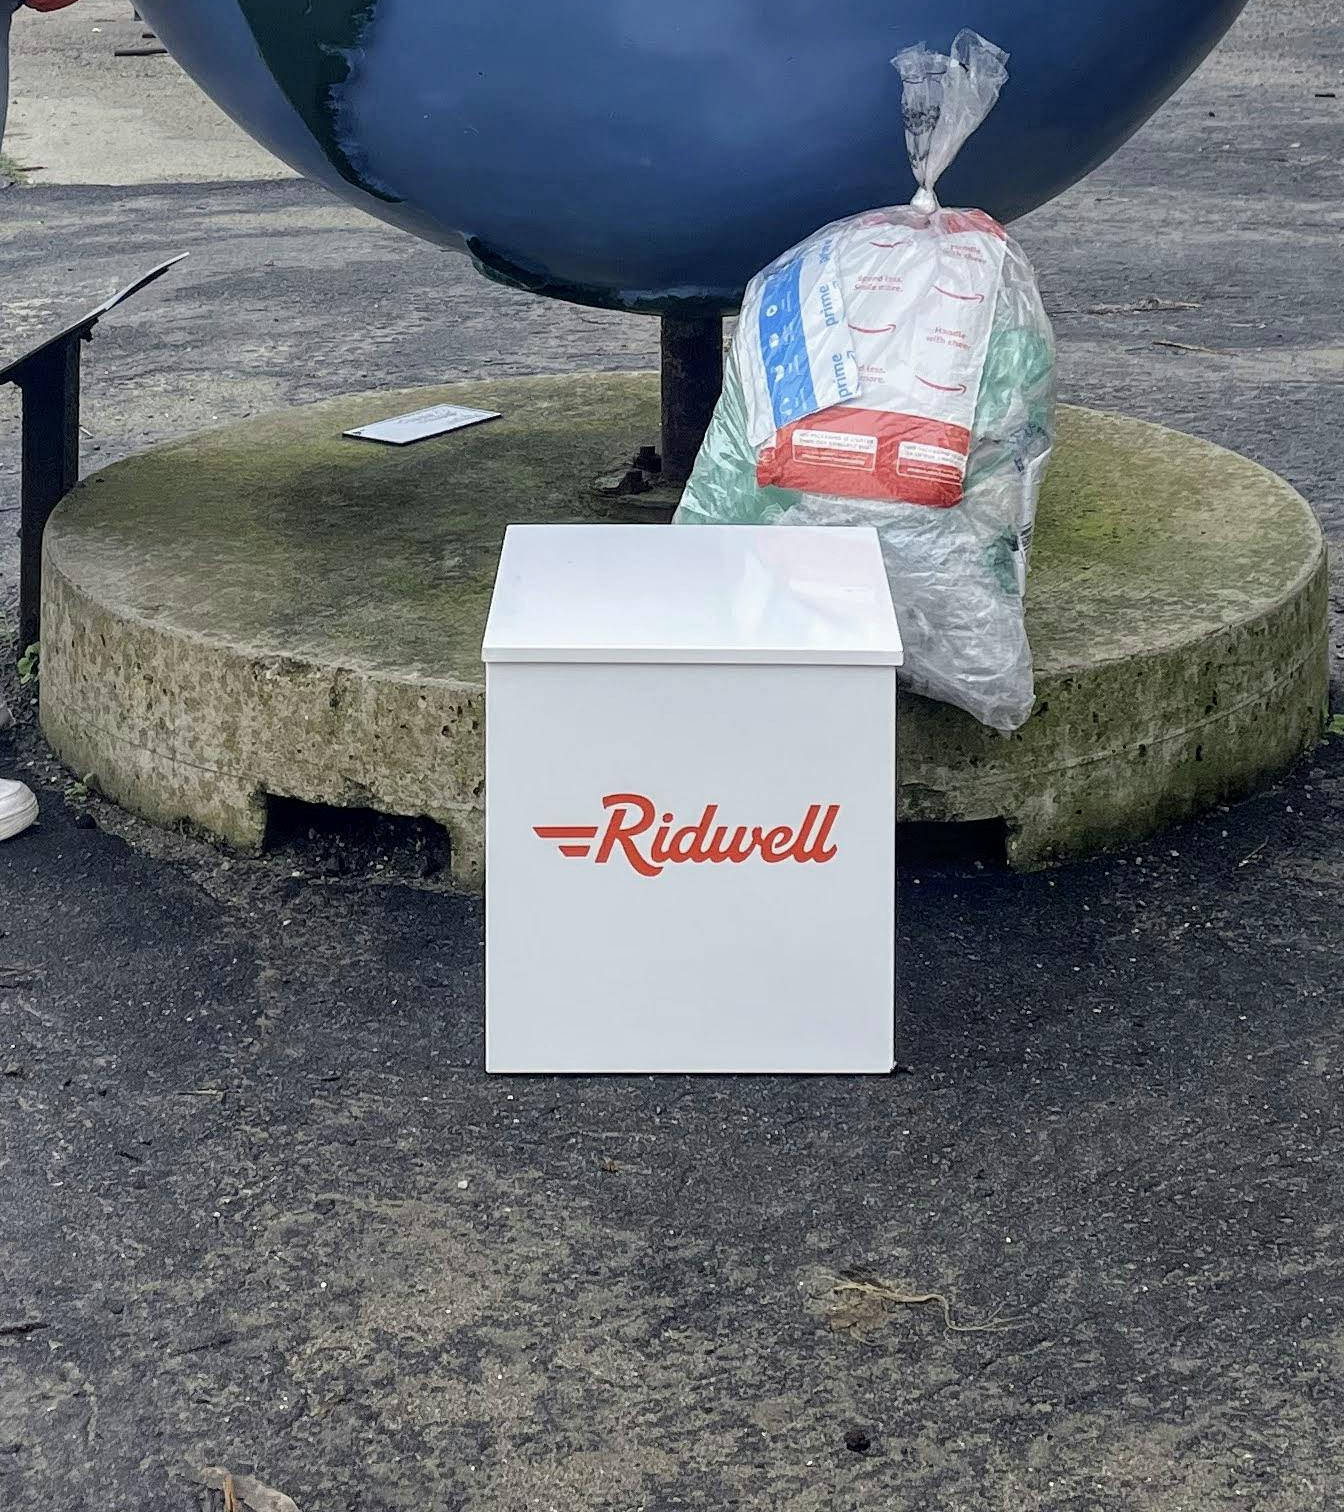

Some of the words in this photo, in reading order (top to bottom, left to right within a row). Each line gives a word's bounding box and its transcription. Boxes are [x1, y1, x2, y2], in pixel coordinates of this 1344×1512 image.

[820, 284, 841, 327] prime
[832, 353, 853, 399] prime
[595, 793, 841, 877] Ridwell
